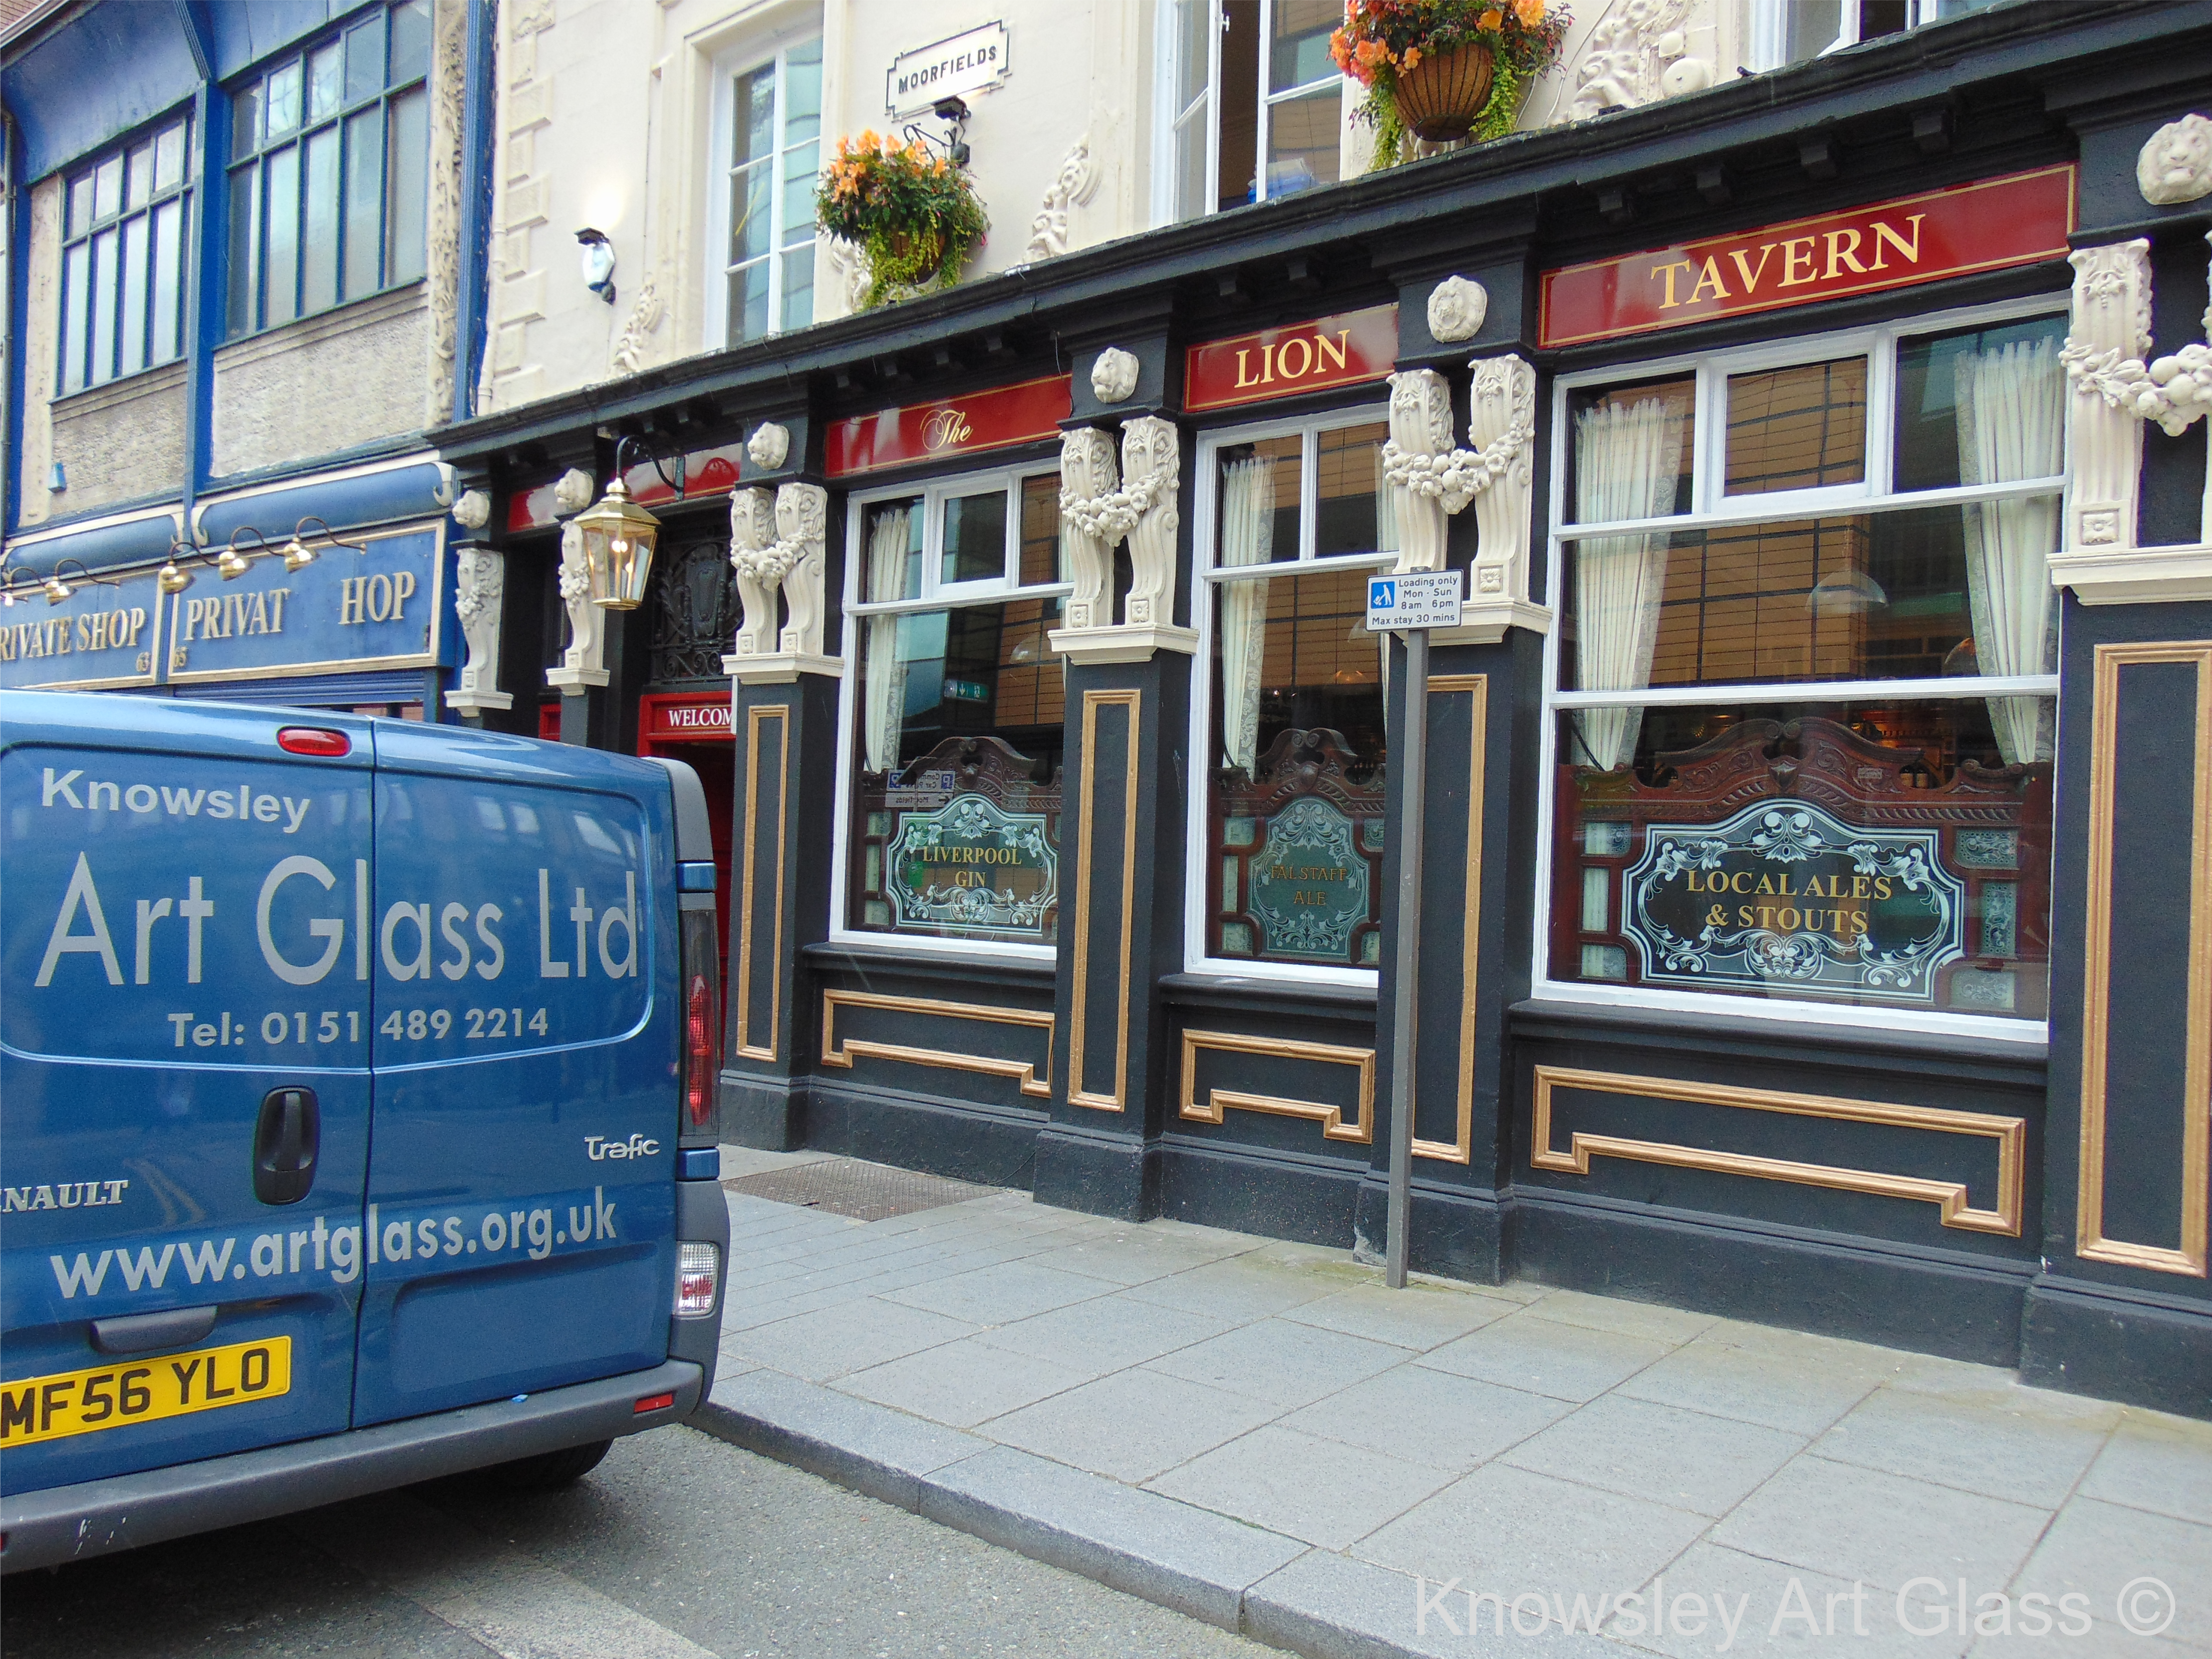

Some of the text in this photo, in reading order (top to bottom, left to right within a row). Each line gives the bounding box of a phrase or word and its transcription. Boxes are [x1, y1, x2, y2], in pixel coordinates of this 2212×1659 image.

[898, 45, 997, 94] MOORFIELDS
[1650, 213, 1926, 310] TAVERN
[1234, 329, 1350, 388] LION
[920, 409, 974, 450] The
[1399, 576, 1458, 588] Loading only
[1404, 590, 1423, 599] Mon
[1433, 588, 1452, 596] Sun
[184, 571, 416, 641] PRIVAT HOP
[1372, 613, 1455, 625] Max stay 30 mins
[77, 607, 146, 652] SHOP
[668, 708, 732, 727] WELCOM
[42, 767, 311, 834] Knowsley
[922, 846, 1022, 865] LIVERPOOL
[955, 871, 986, 888] GIN
[1270, 865, 1348, 882] FALSTAFF
[1686, 870, 1892, 900] LOCAL ALES
[1293, 890, 1326, 906] ALE
[34, 851, 637, 987] Art Glass Ltd
[1705, 903, 1868, 934] & STOUTS
[168, 1007, 548, 1047] Tel: 0151 489 2214
[584, 1134, 660, 1161] Trafic
[0, 1180, 129, 1213] NAULT
[50, 1185, 617, 1299] www.artglass.org.uk
[0, 1347, 270, 1439] MF56 YLO
